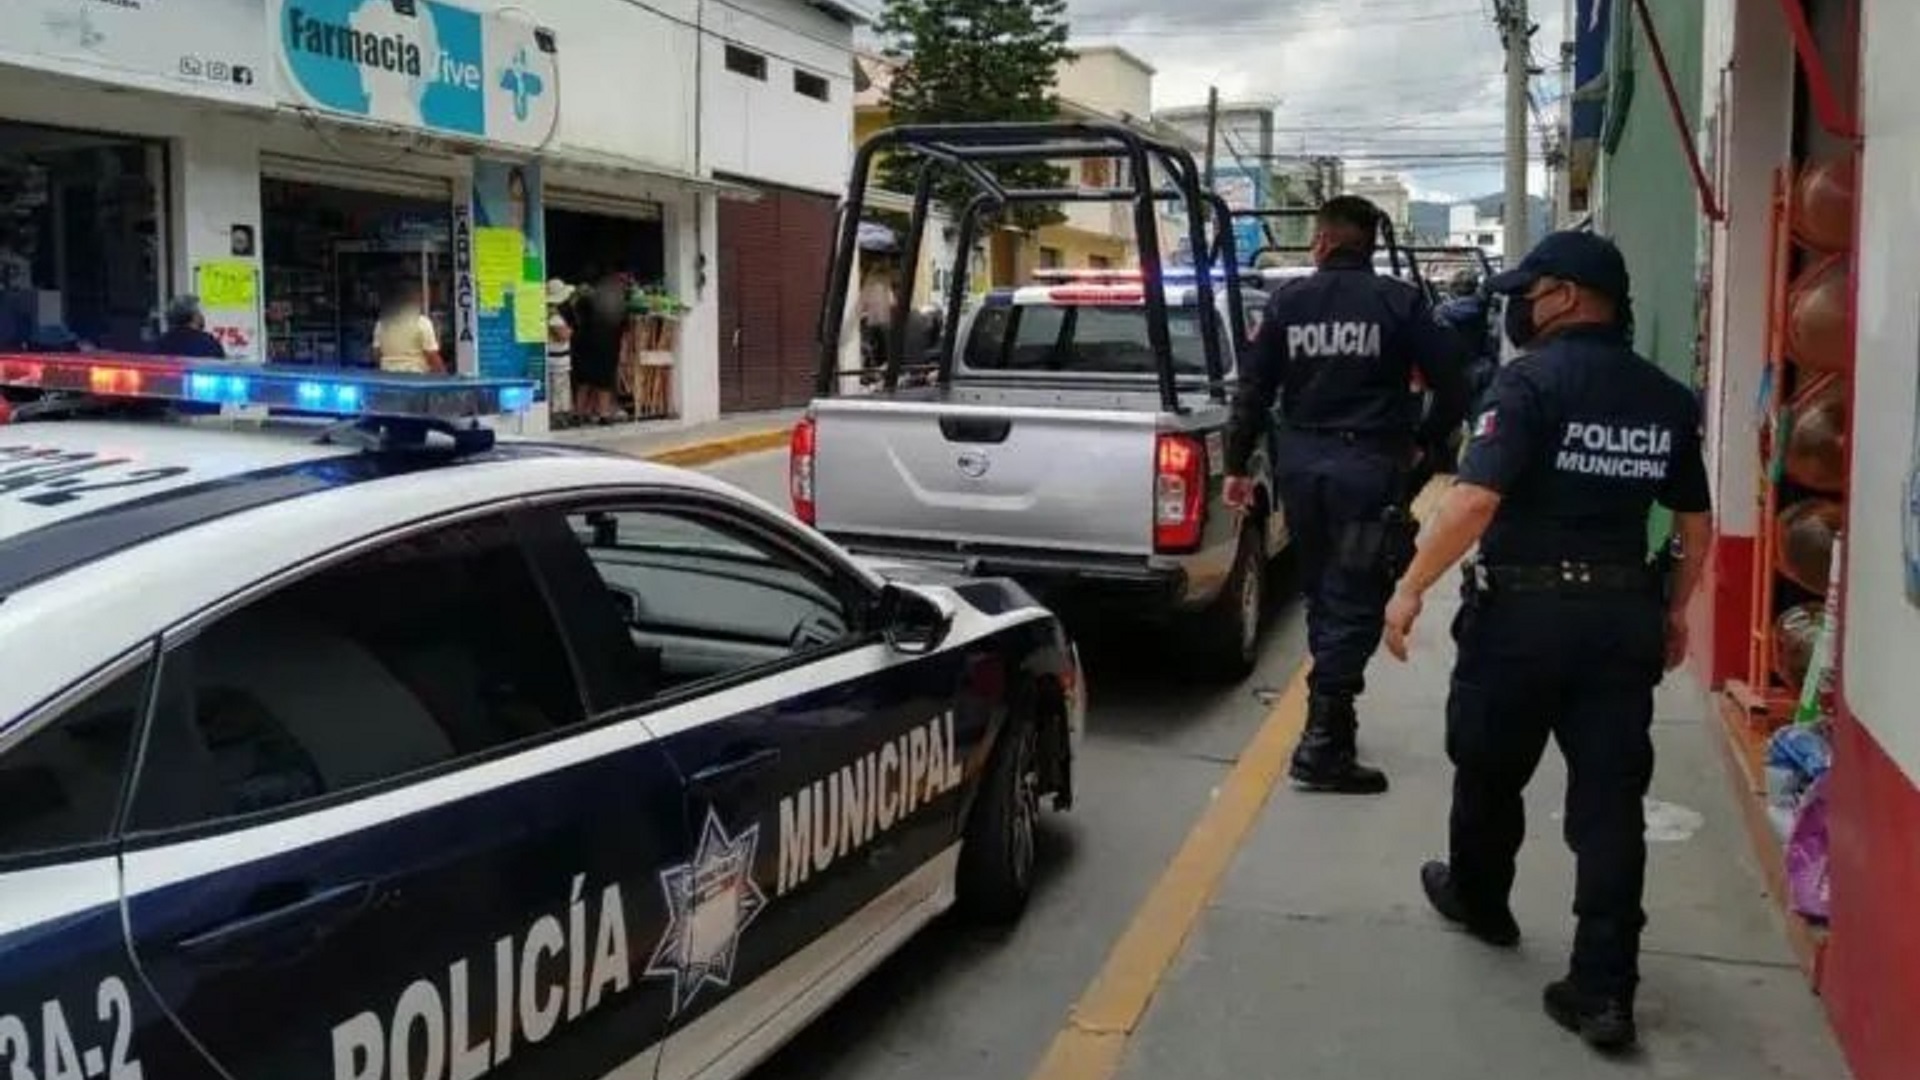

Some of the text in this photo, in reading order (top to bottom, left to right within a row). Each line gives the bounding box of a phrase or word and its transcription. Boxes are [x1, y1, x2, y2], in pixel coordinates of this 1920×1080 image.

[289, 8, 421, 76] Farmacia
[331, 711, 963, 1080] POLICÍA MUNICIPAL
